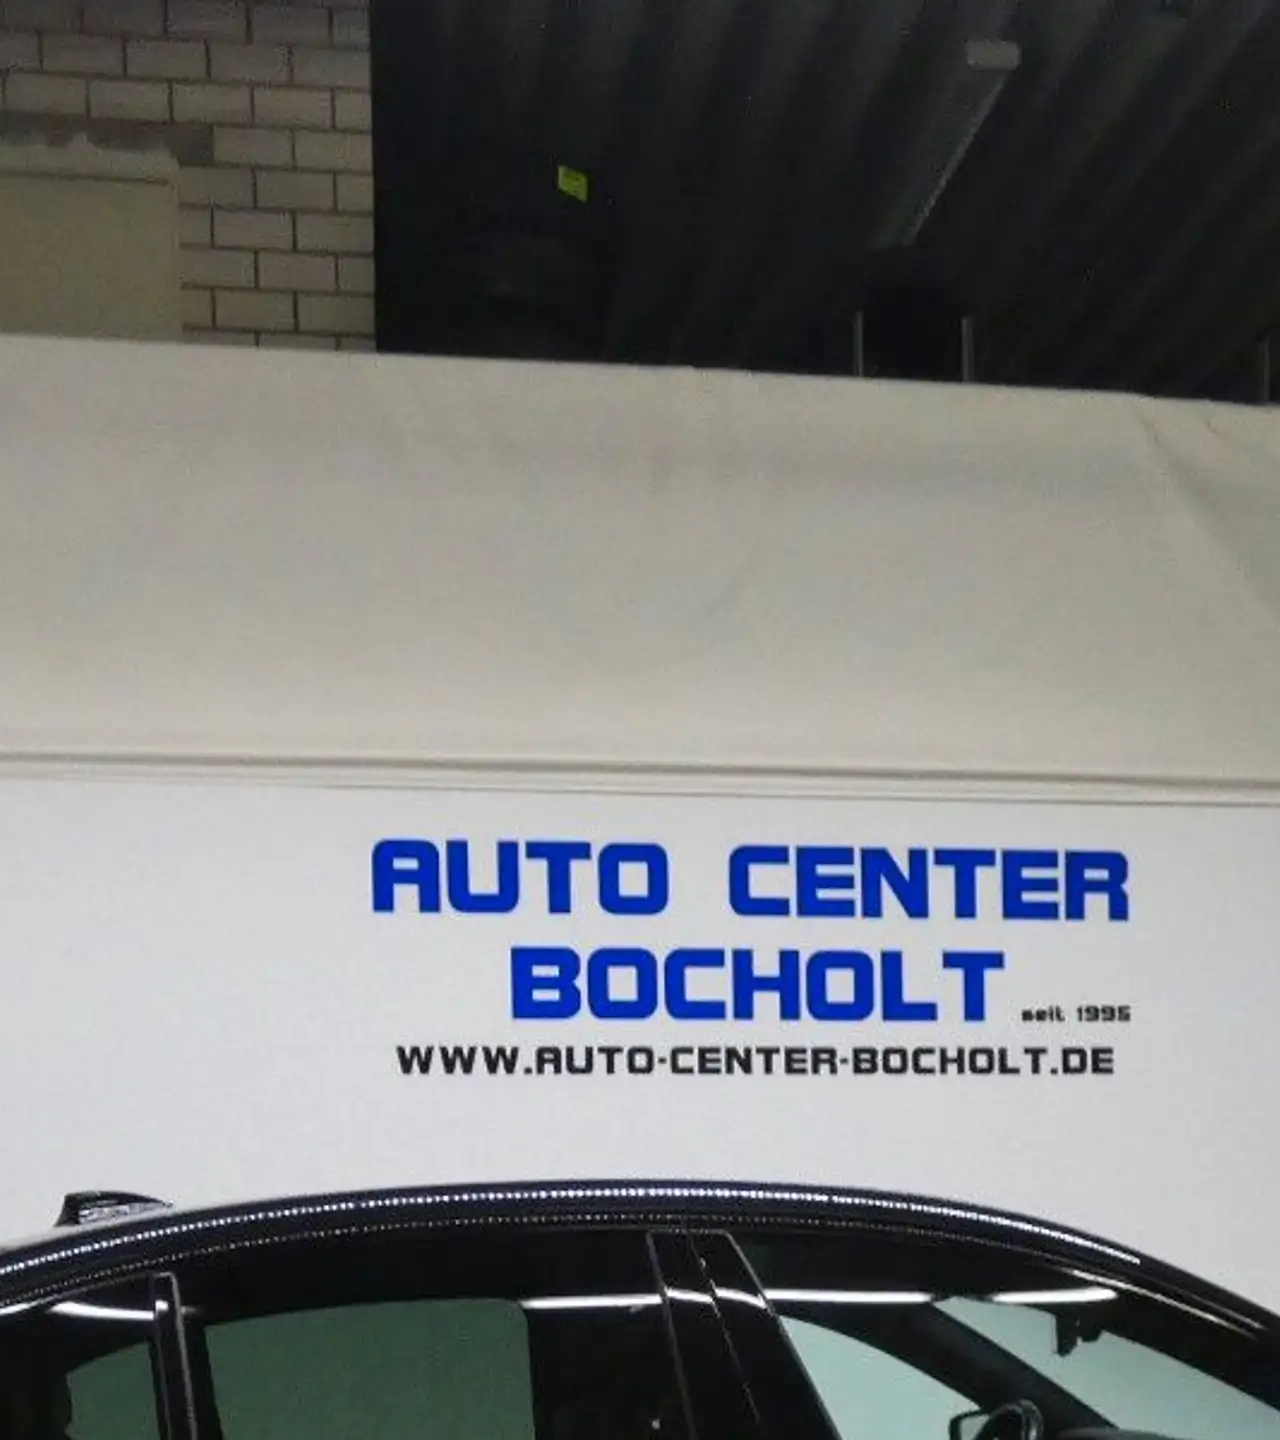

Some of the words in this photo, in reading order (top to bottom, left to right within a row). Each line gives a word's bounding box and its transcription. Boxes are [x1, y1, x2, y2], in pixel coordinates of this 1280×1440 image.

[372, 837, 671, 917] AUTO
[729, 844, 1131, 922] CENTER
[510, 945, 1007, 1024] BOCHOLT
[1021, 1004, 1066, 1022] seit
[1076, 1004, 1132, 1022] 1995
[396, 1045, 1114, 1075] WWW.AUTO-CENTER-BOCHOLT.DE
